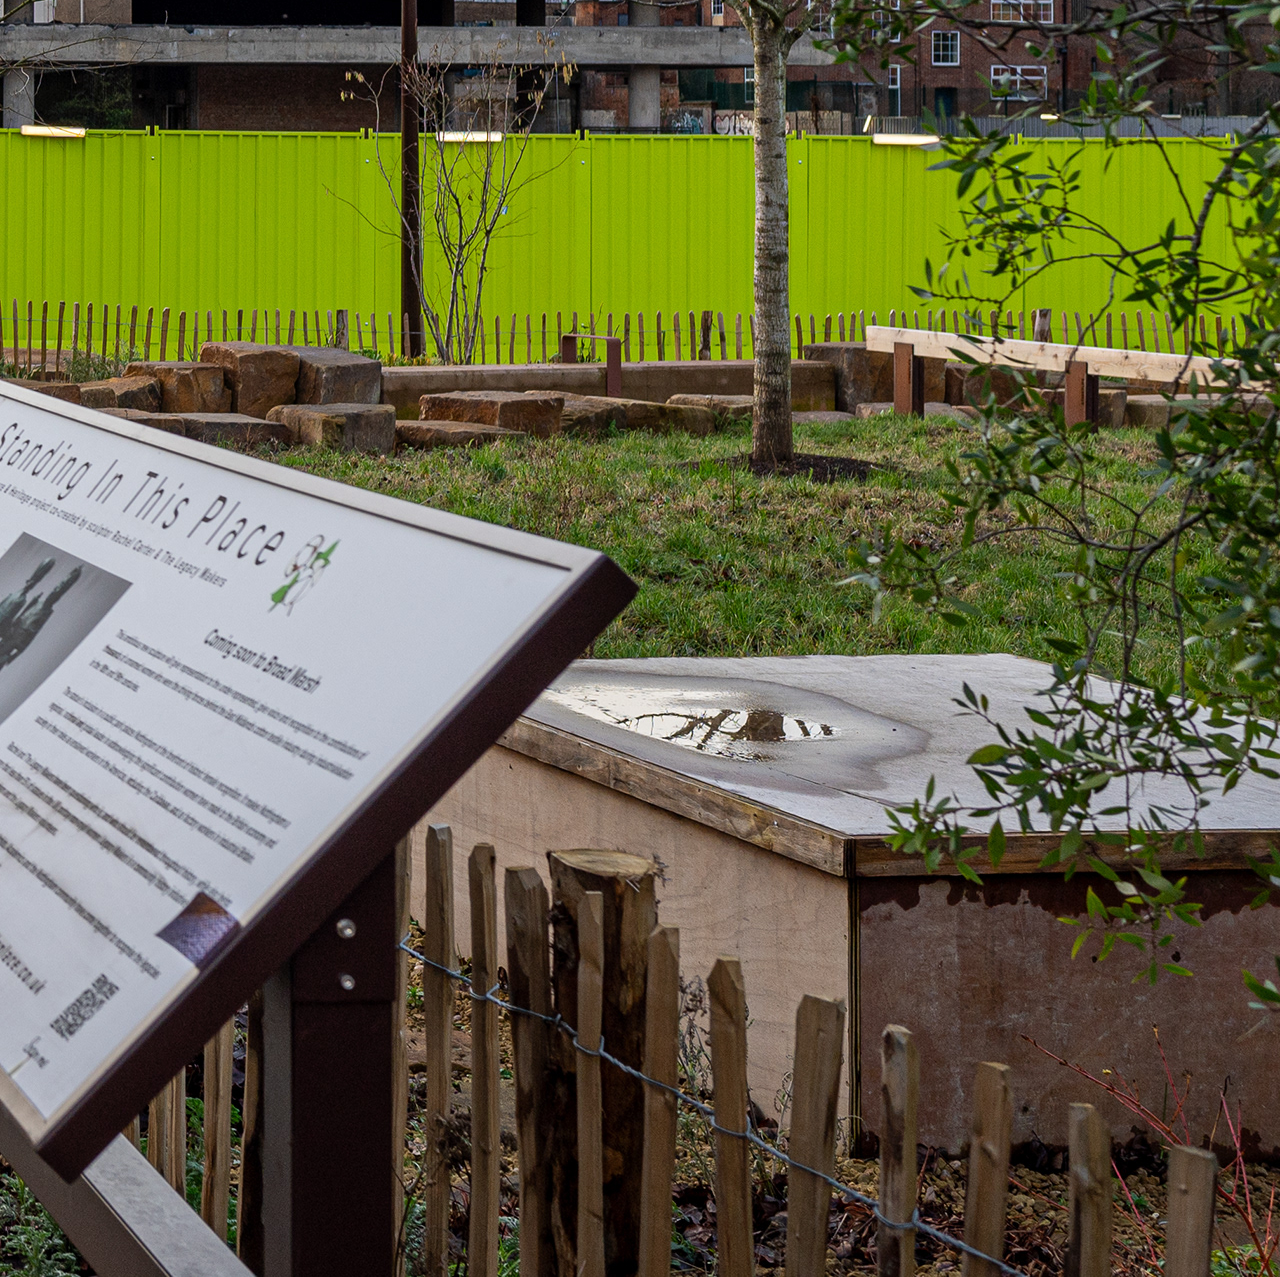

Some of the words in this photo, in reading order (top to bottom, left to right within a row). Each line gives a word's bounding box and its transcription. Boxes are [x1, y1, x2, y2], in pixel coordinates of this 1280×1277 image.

[9, 487, 32, 504] Heritage
[30, 498, 53, 511] project
[49, 506, 81, 525] co-created
[77, 517, 88, 530] by
[86, 522, 113, 538] sculptor
[111, 530, 133, 548] Rachel
[132, 538, 156, 557] Carter
[164, 550, 176, 566] The
[174, 558, 200, 579] Legacy
[199, 568, 227, 587] Makers
[87, 459, 123, 504] In
[123, 471, 189, 529] This
[187, 495, 285, 566] Place
[204, 629, 238, 659] Coming
[232, 646, 258, 664] soon
[252, 653, 267, 669] to
[262, 656, 296, 681] Broad
[287, 667, 321, 694] Marsh
